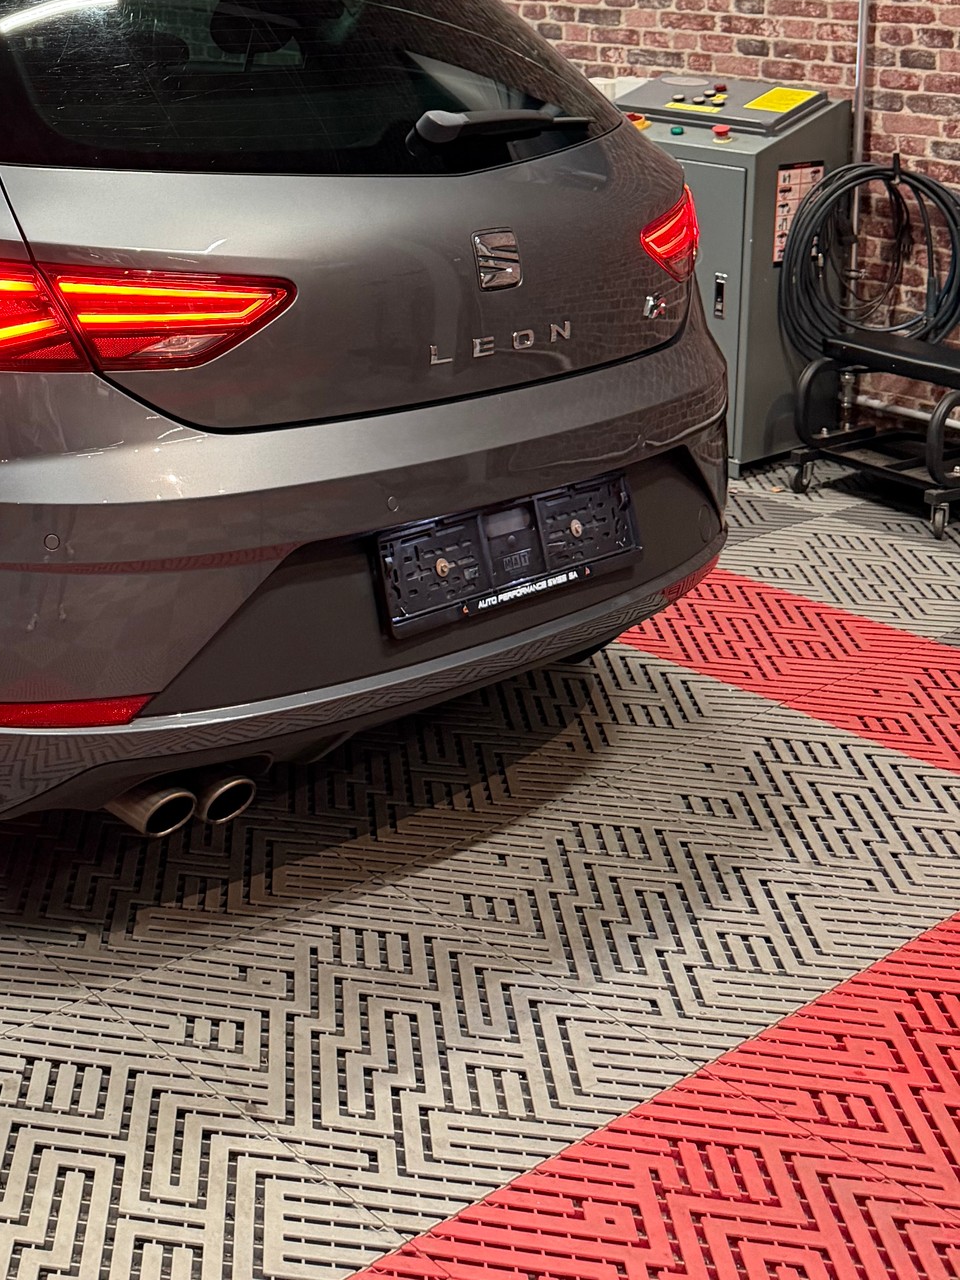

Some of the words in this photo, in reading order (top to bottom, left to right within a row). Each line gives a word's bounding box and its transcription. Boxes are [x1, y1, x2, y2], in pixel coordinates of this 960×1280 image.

[429, 320, 572, 365] LEON
[478, 596, 497, 609] AUTO
[498, 581, 547, 602] PERFORMANCE
